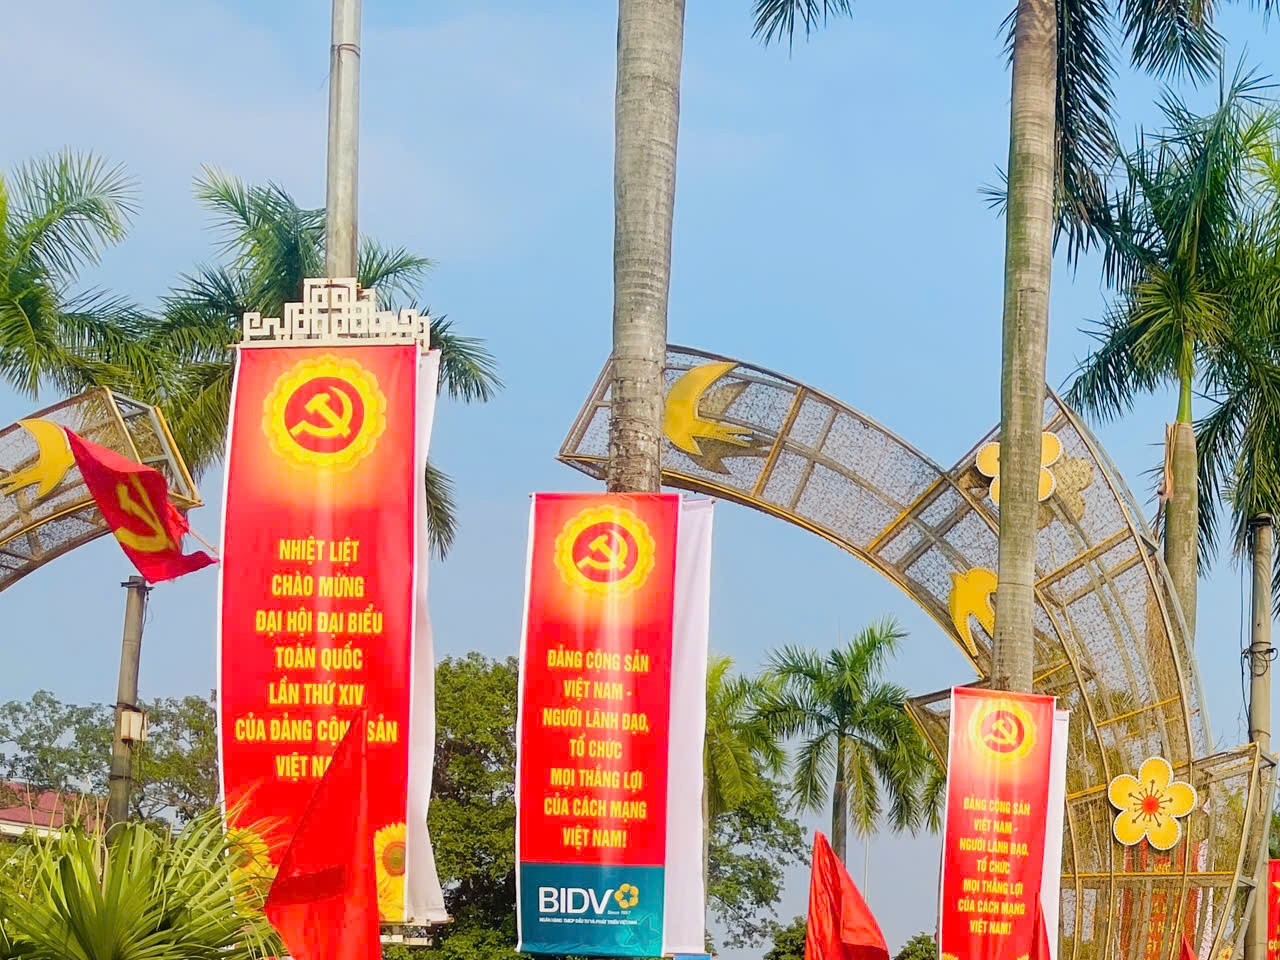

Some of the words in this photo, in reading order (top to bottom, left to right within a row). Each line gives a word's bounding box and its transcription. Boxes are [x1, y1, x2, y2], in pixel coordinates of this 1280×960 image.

[280, 536, 325, 564] NHIỆT
[330, 537, 359, 566] LIỆT
[272, 571, 313, 596] CHÀO
[319, 573, 364, 597] MỪNG
[256, 610, 282, 636] ĐẠI
[288, 607, 312, 636] HỘI
[317, 612, 343, 638] ĐẠI
[348, 604, 383, 633] BIỂU
[276, 643, 315, 667] TOÀN
[322, 640, 362, 671] QUỐC
[548, 644, 582, 668] ĐẢNG
[586, 648, 620, 672] CỘNG
[624, 650, 649, 672] SẢN
[270, 675, 299, 704] LẦN
[304, 680, 335, 704] THỨ
[339, 685, 364, 705] XIV
[564, 677, 590, 701] VIỆT
[594, 682, 622, 700] NAM
[236, 712, 265, 740] CỦA
[271, 712, 312, 740] ĐẢNG
[317, 716, 350, 745] CỘN
[368, 714, 397, 742] SẢN
[544, 706, 581, 726] NGƯỜI
[586, 709, 618, 730] LÃNH
[622, 713, 648, 734] ĐẠO,
[570, 733, 585, 757] TỔ
[589, 739, 622, 759] CHỨC
[276, 752, 306, 781] VIỆT
[312, 756, 333, 776] NA
[551, 768, 574, 789] MỌI
[579, 764, 620, 788] THẮNG
[624, 772, 642, 792] LỢI
[544, 792, 569, 815] CỦA
[573, 795, 606, 816] CÁCH
[610, 801, 646, 822] MẠNG
[563, 826, 590, 850] VIỆT
[592, 829, 627, 847] NAM!
[538, 886, 614, 915] BIDV
